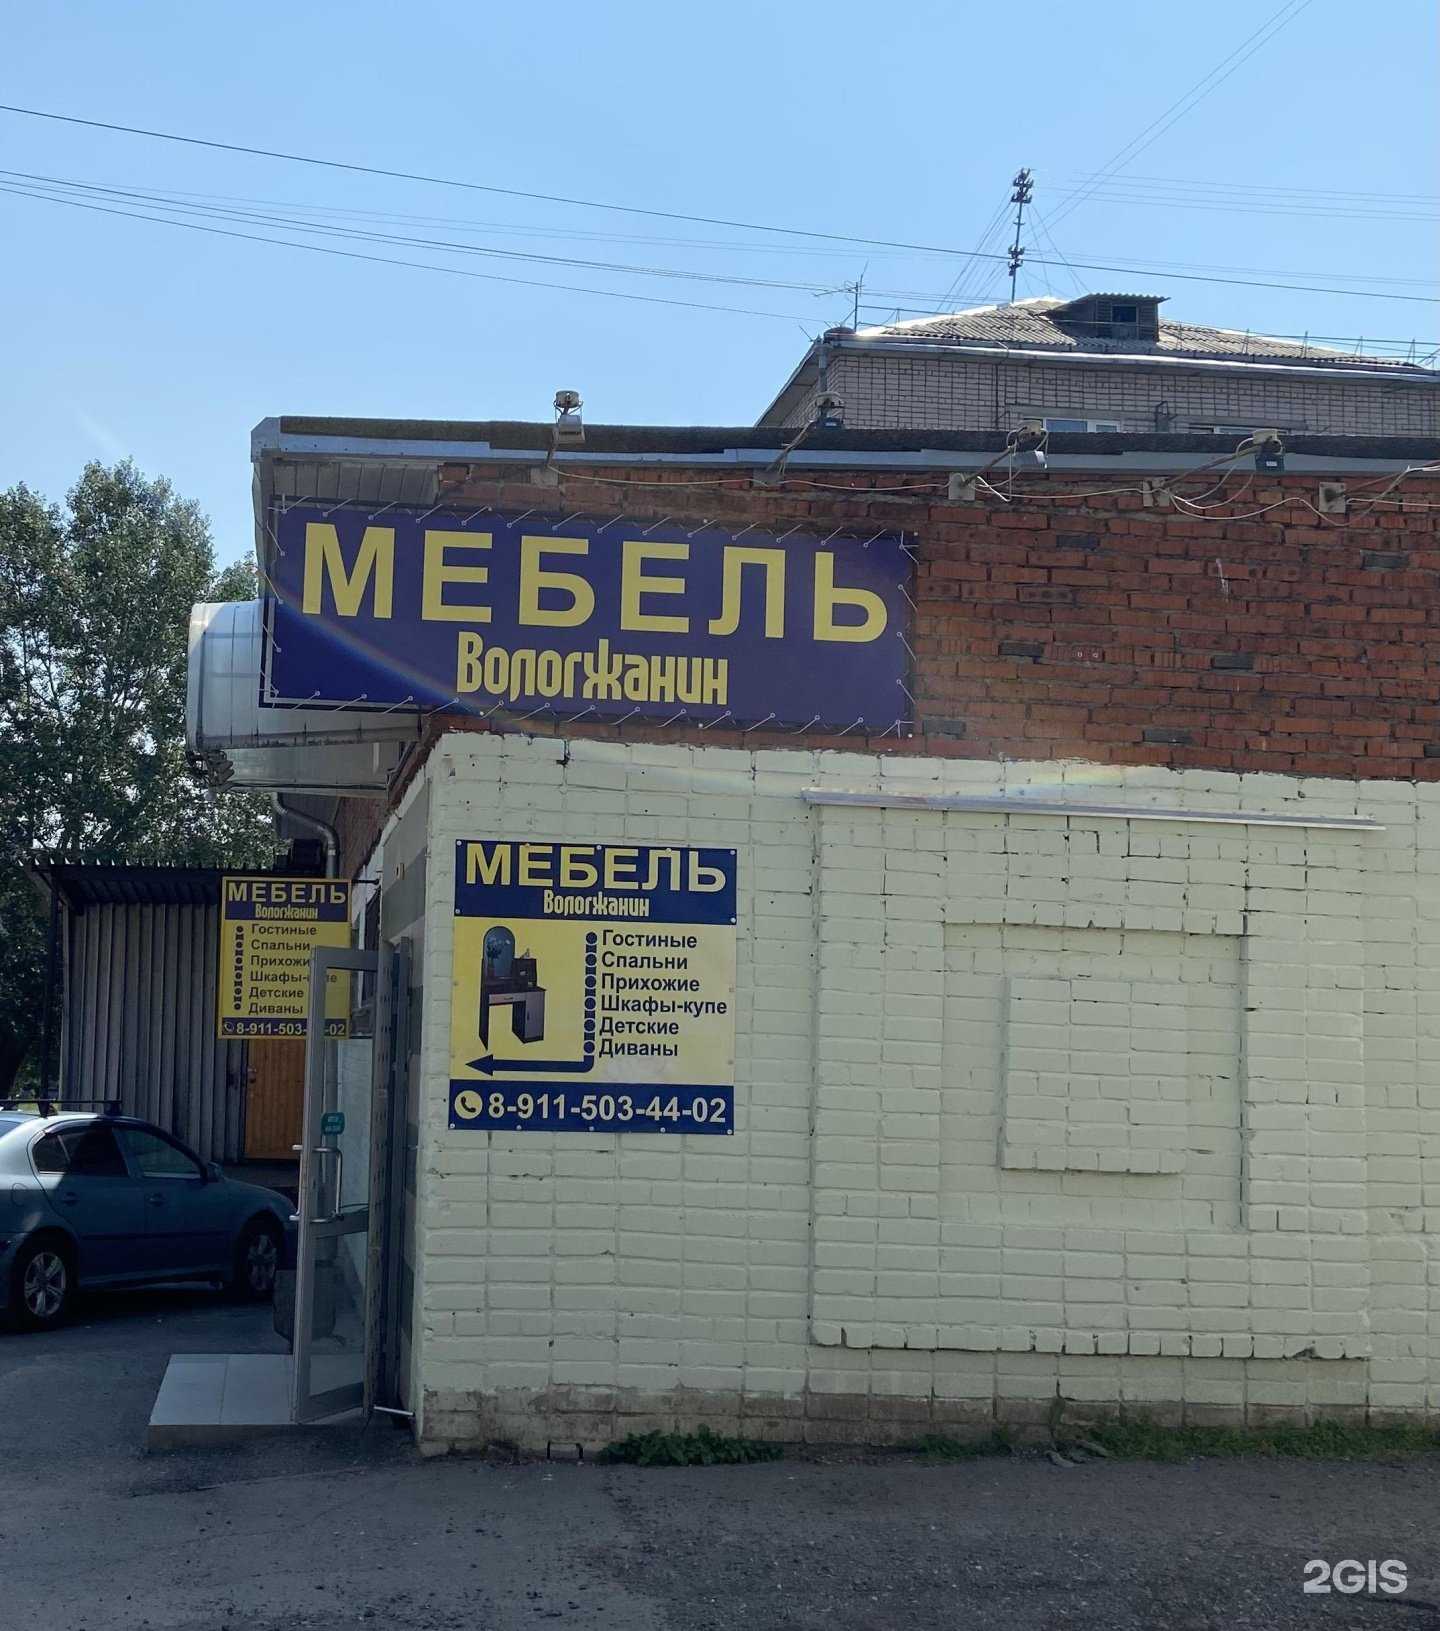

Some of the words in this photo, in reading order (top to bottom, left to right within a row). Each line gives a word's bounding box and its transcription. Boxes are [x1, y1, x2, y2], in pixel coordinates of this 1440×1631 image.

[302, 522, 889, 643] МЕБЕЛЬ
[456, 631, 729, 706] Вологжанин
[466, 843, 726, 892] МЕБЕЛЬ
[228, 882, 346, 904] МЕБЕЛЬ
[543, 889, 650, 917] Вологжанин
[255, 903, 318, 920] Вологжанин
[251, 923, 317, 936] Гостиные
[602, 929, 698, 949] Гостиные
[251, 939, 311, 951] Спальни
[250, 955, 310, 968] Прихожи
[601, 951, 688, 970] Спальни
[249, 986, 304, 999] Детские
[601, 973, 700, 993] Прихожие
[248, 1002, 303, 1016] Диваны
[601, 995, 727, 1017] Шкафы-купе
[236, 1022, 345, 1036] 8-911-503--02
[600, 1016, 679, 1037] Детские
[599, 1038, 679, 1058] Диваны
[488, 1092, 726, 1124] 8-911-503-44-02
